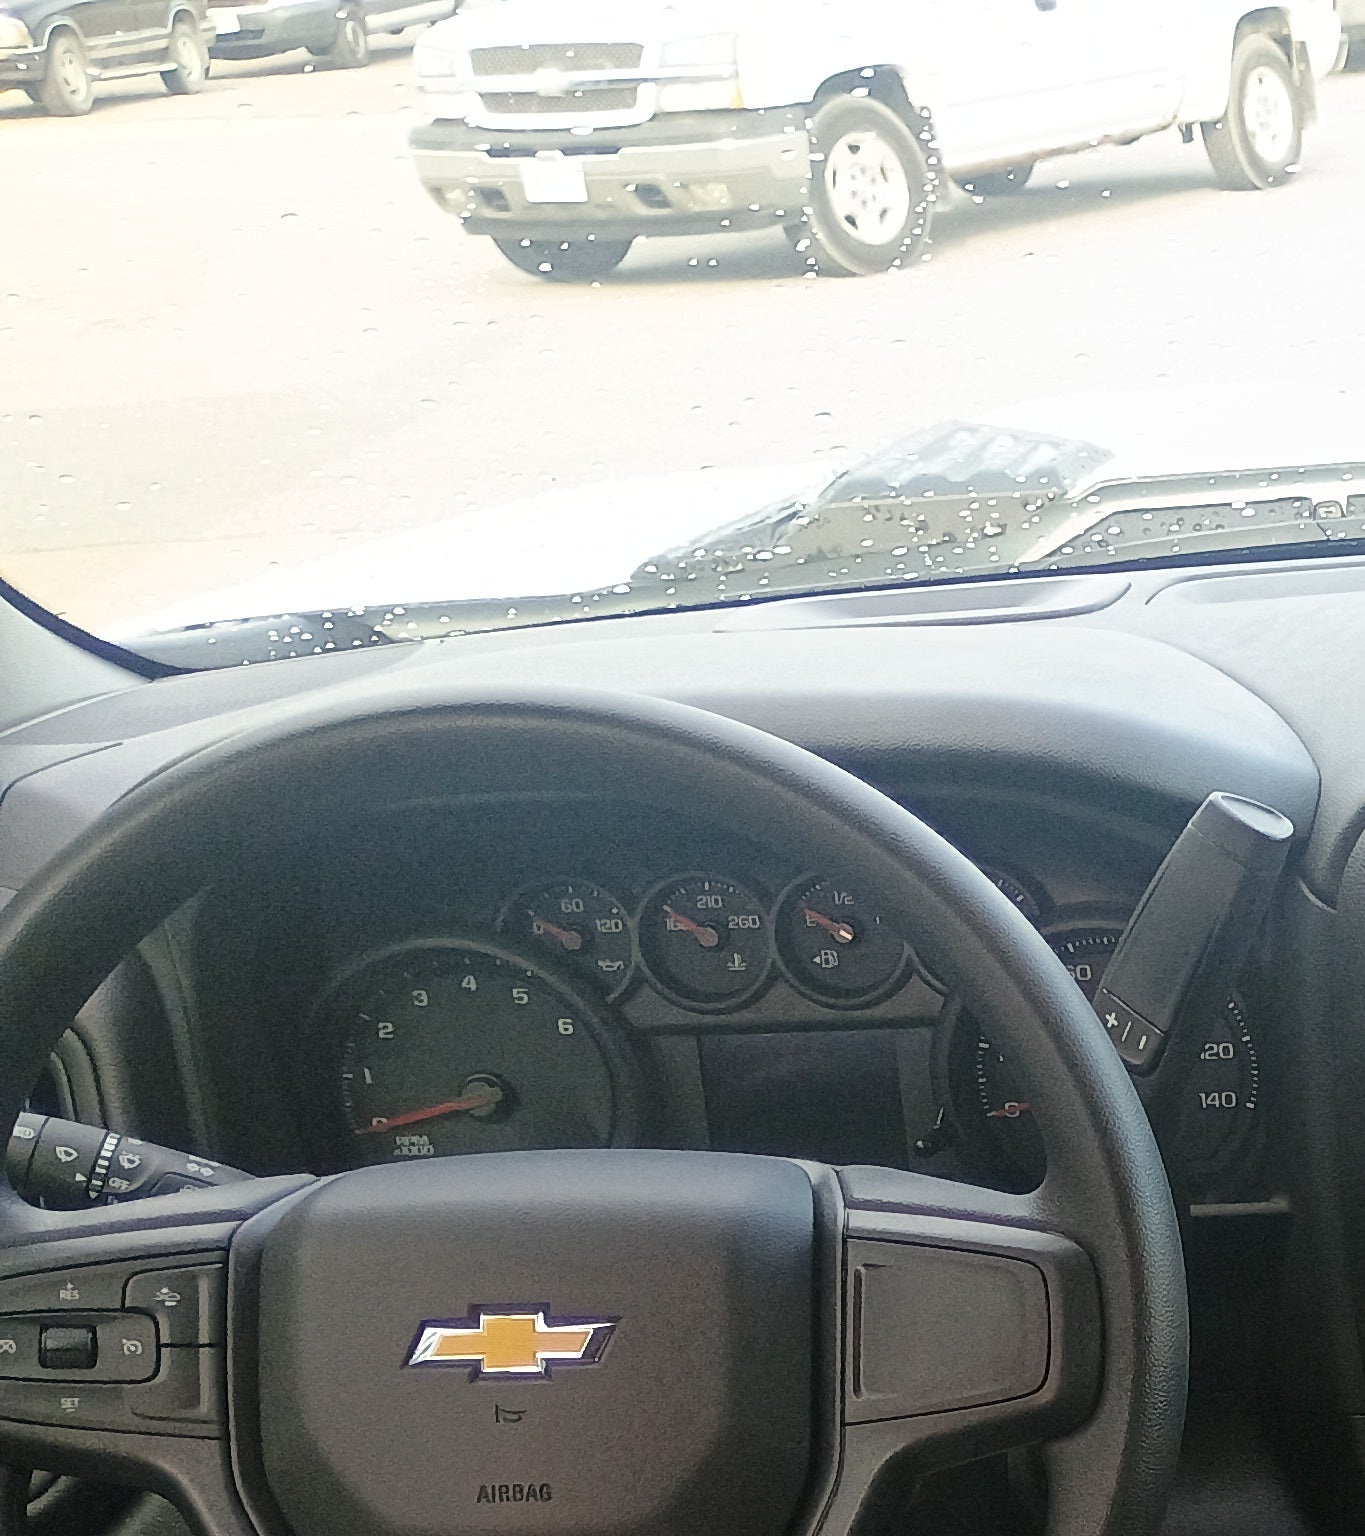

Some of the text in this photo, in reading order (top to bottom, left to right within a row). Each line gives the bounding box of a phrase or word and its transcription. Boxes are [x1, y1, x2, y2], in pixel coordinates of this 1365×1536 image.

[561, 899, 583, 913] 60
[697, 896, 722, 909] 210
[596, 919, 622, 933] 120
[729, 915, 759, 929] 260
[461, 975, 477, 991] 4
[412, 989, 428, 1006] 3
[512, 988, 528, 1004] 5
[378, 1022, 394, 1038] 2
[558, 1018, 574, 1034] 6
[363, 1067, 373, 1084] 1
[1199, 1091, 1237, 1109] 140
[476, 1483, 552, 1503] AIRBAG
